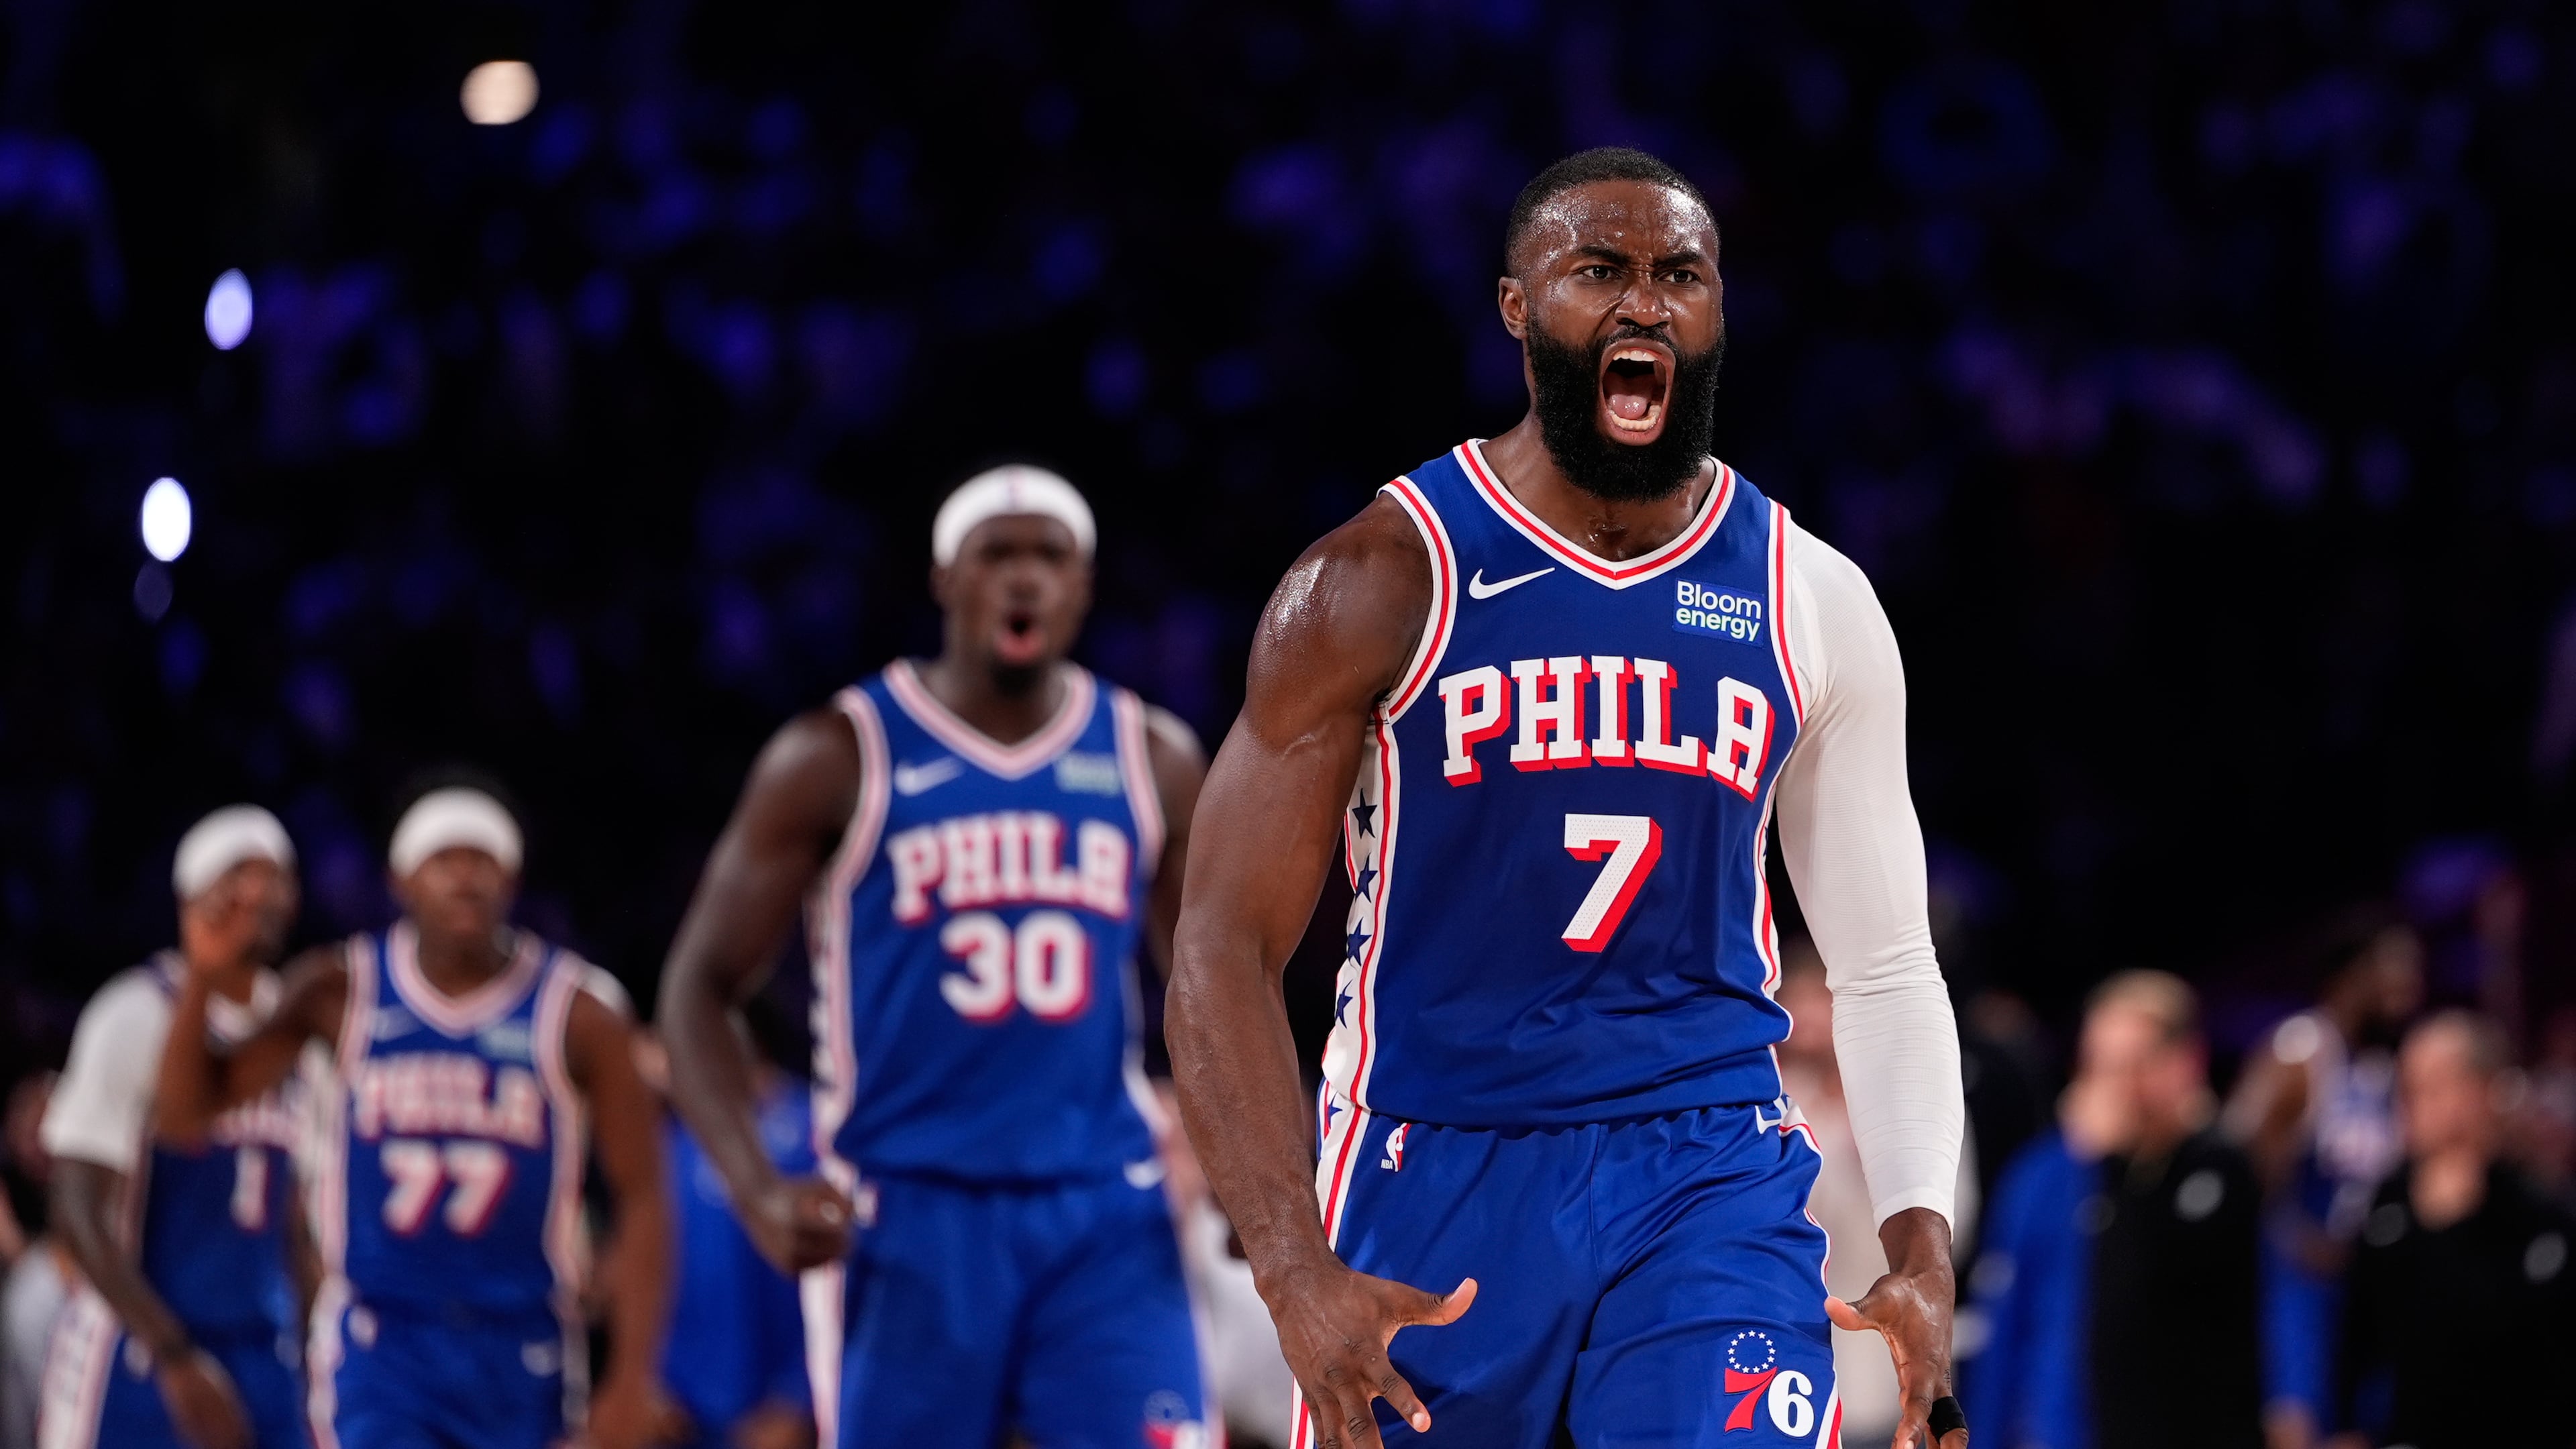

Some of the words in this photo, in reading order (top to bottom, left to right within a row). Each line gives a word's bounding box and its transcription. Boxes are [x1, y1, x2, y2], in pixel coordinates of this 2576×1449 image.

[1676, 608, 1760, 642] energy
[1677, 580, 1762, 619] Bloom
[1438, 655, 1775, 804] PHILA
[888, 810, 1132, 924] PHILA
[1561, 813, 1662, 953] 7
[940, 910, 1092, 1024] 30
[378, 1139, 515, 1236] 77
[1381, 1159, 1393, 1170] NBA
[1724, 1366, 1814, 1438] 76
